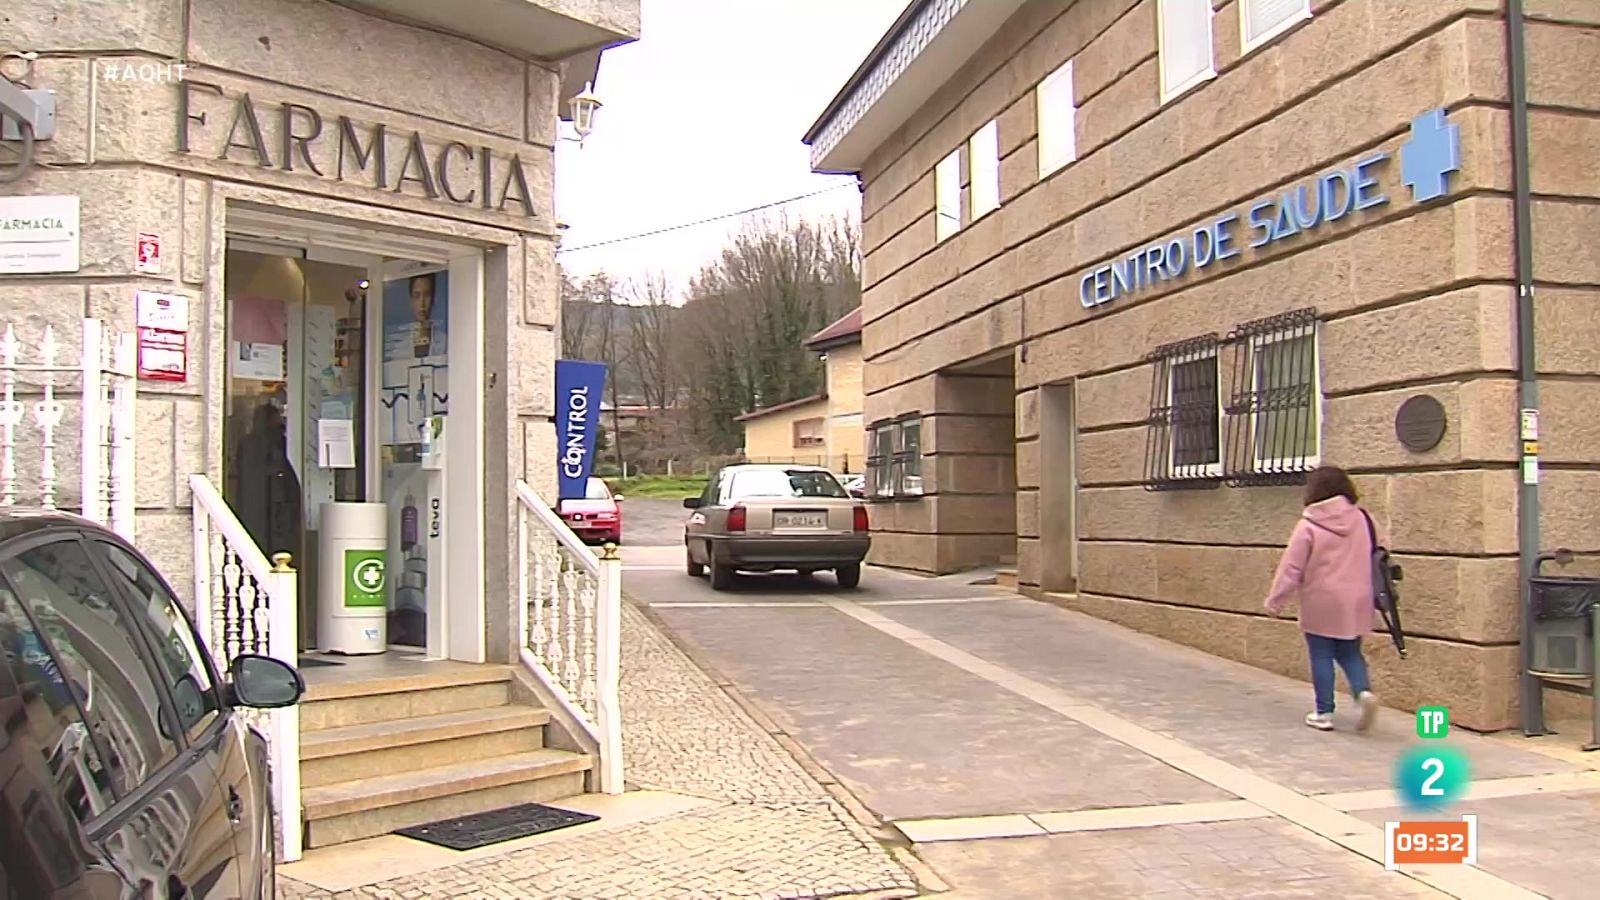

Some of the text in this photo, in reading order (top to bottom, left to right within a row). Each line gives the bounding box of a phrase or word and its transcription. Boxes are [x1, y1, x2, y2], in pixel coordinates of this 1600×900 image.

[176, 79, 537, 216] FARMACIA
[1079, 153, 1390, 308] CENTRO DE SAUDE
[561, 386, 589, 478] CONTROL
[429, 499, 440, 538] teva
